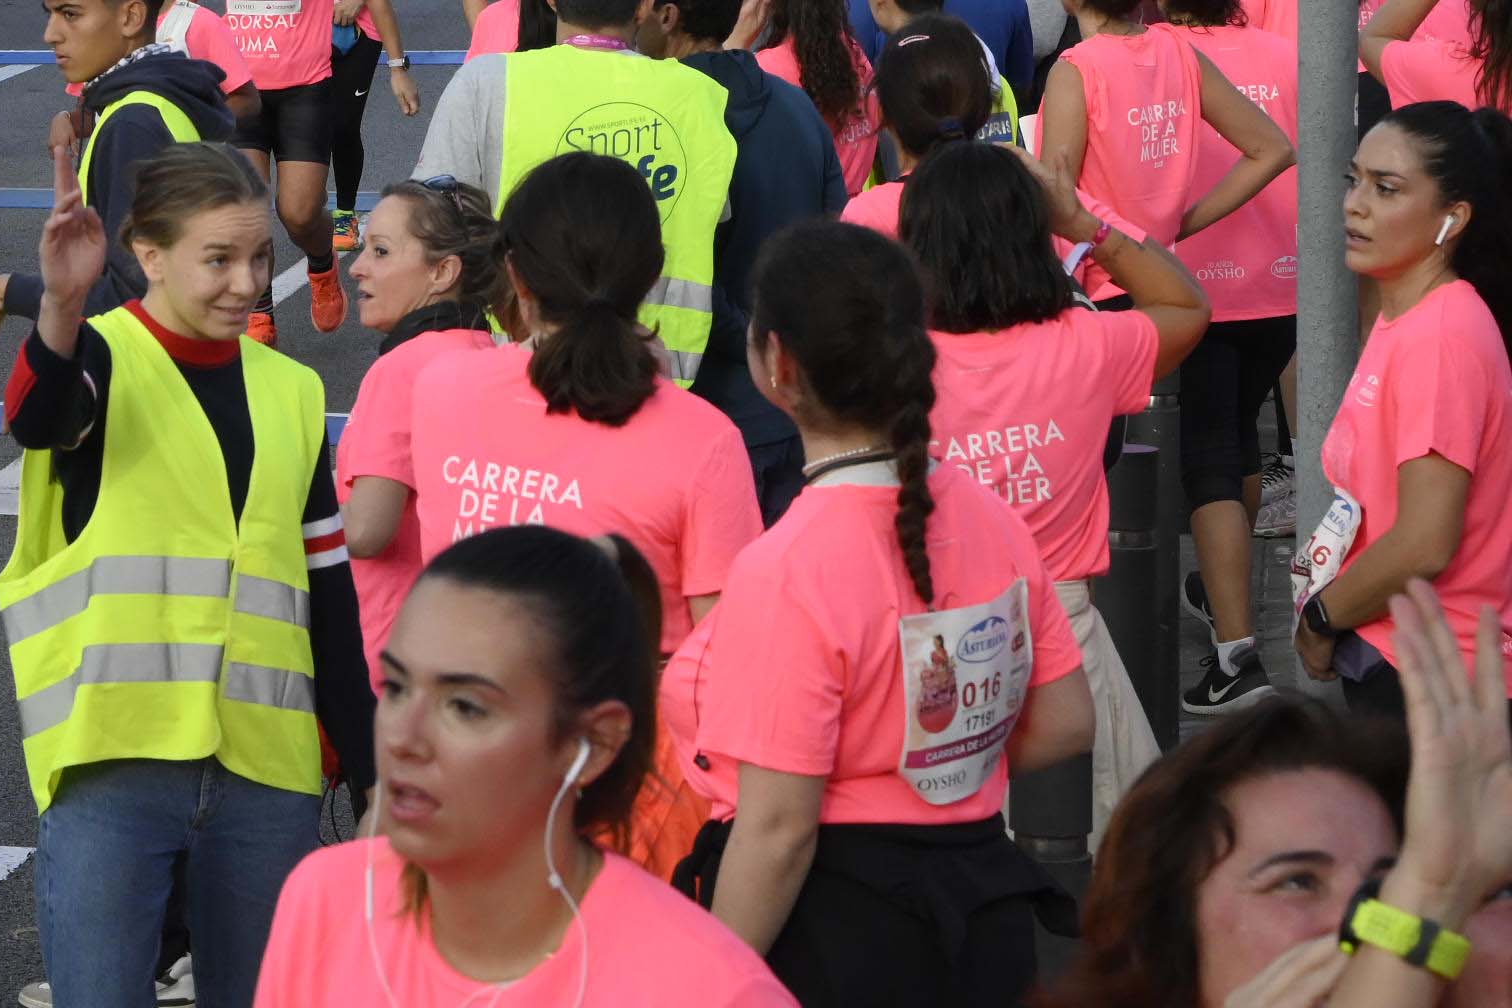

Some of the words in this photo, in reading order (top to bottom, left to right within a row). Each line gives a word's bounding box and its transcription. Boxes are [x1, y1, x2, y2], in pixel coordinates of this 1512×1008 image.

[228, 14, 297, 30] DORSAL
[1197, 266, 1245, 281] OYSHO
[929, 418, 1065, 461] ARRERA
[1005, 451, 1044, 479] LA
[443, 455, 582, 509] CARRERA
[459, 488, 499, 522] DE
[509, 497, 544, 526] LA
[962, 672, 1001, 708] 016
[925, 745, 965, 763] CARRERA
[917, 769, 966, 792] OYSHO
